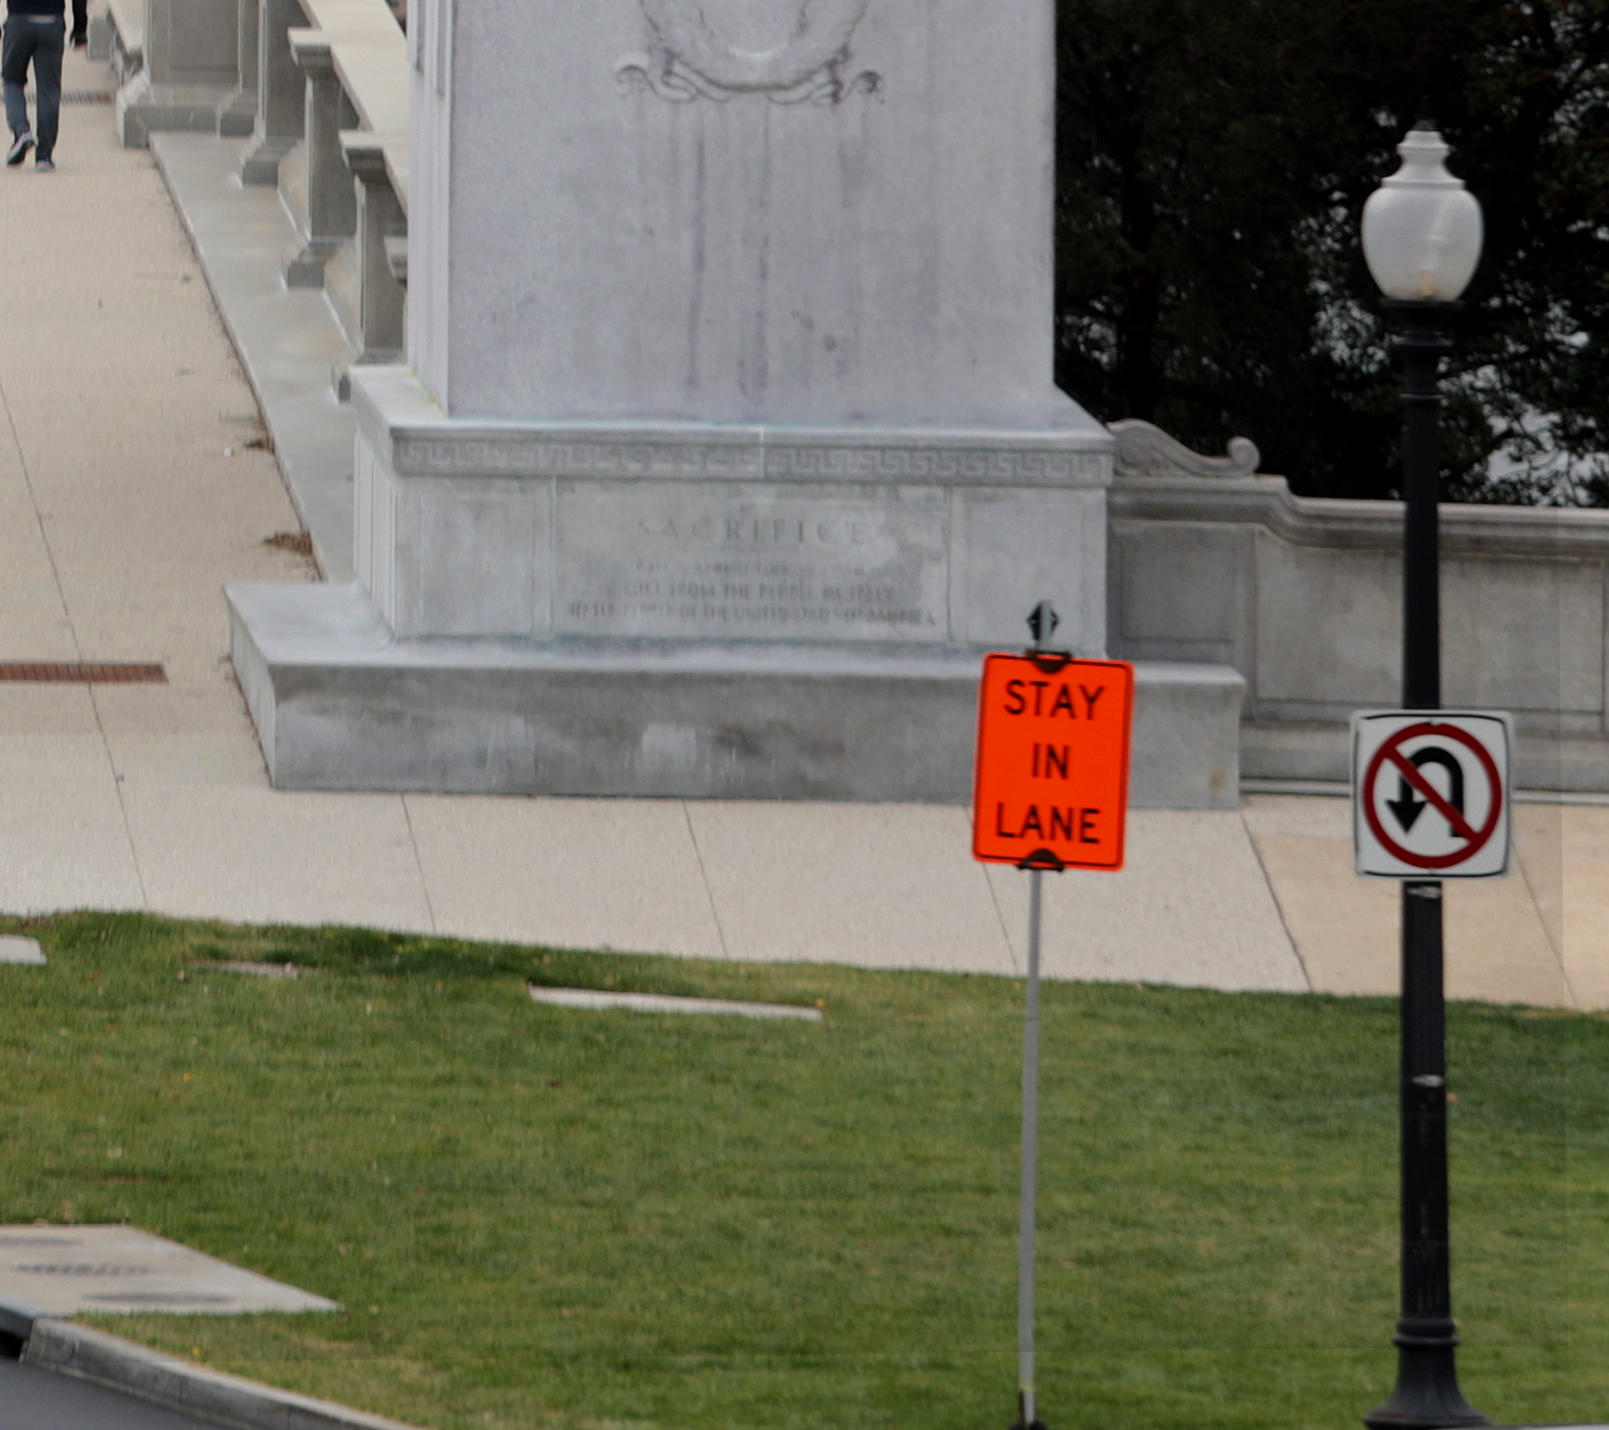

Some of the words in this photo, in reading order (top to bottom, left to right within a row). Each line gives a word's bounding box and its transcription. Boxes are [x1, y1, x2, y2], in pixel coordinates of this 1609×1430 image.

[637, 516, 867, 545] SACRIFICE
[1003, 679, 1107, 720] STAY
[1031, 742, 1070, 781] IN
[996, 801, 1101, 845] LANE
